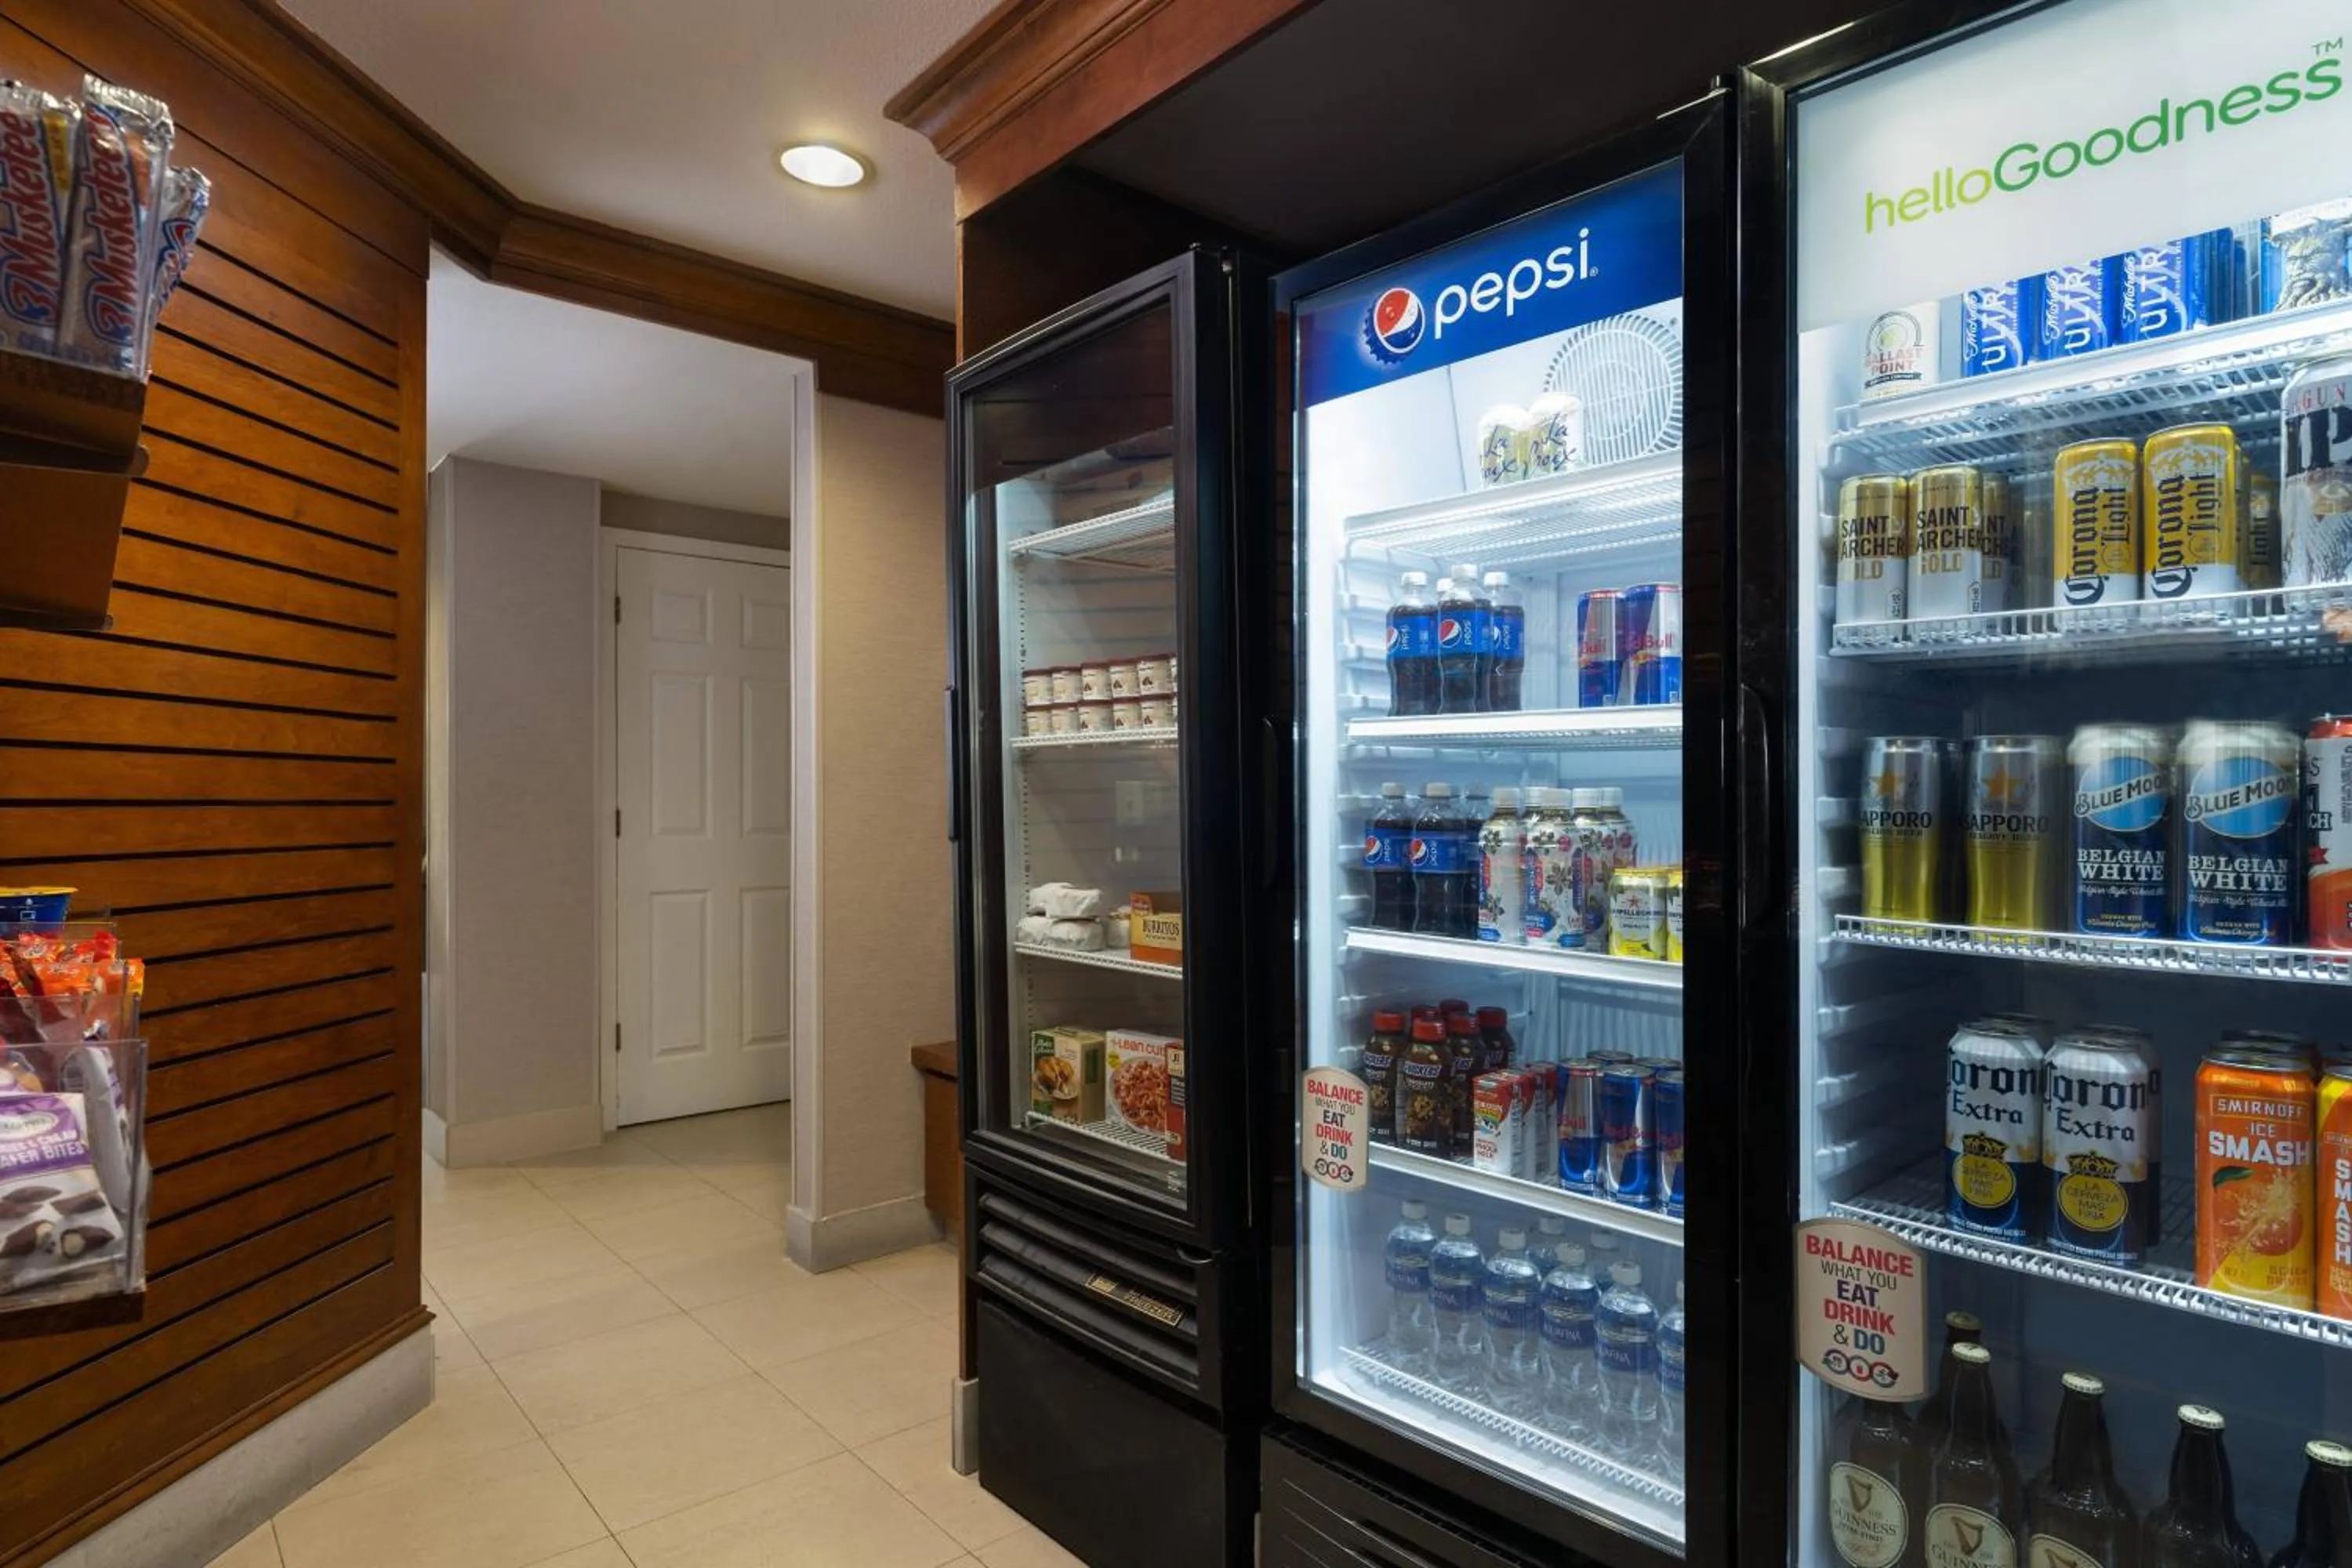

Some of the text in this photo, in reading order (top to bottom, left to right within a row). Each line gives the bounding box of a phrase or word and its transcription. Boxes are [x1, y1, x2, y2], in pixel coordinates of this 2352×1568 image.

[1865, 59, 2342, 234] helloGoodness
[1, 111, 59, 289] Musketee
[1435, 228, 1589, 339] pepsi
[2140, 252, 2167, 332] ULTR
[2064, 271, 2091, 350] ULTR
[1981, 291, 2007, 366] ULTR
[1841, 515, 1889, 537] SAINT
[1916, 506, 1969, 529] SAINT
[1840, 536, 1906, 560] ARCHER
[2063, 487, 2110, 606] Corona
[2151, 474, 2198, 599] Corona
[1861, 809, 1933, 829] APPORO
[2077, 848, 2166, 864] BELGIAN
[2078, 862, 2165, 881] WHITE
[2187, 855, 2288, 873] BELGIAN
[2188, 869, 2287, 891] WHITE
[1307, 1078, 1363, 1105] BALANCE
[1949, 1058, 2037, 1096] oron
[1339, 1102, 1356, 1116] YOU
[1952, 1091, 2024, 1125] Extra
[2056, 1105, 2136, 1142] Extra
[2218, 1098, 2304, 1117] SMIRNOFF
[1316, 1123, 1354, 1146] DRINK
[2249, 1123, 2277, 1138] ICE
[1330, 1143, 1348, 1160] DO
[2208, 1130, 2311, 1167] SMASH
[1806, 1233, 1914, 1278] BALANCE
[1820, 1259, 1898, 1291] WHAT YOU
[1824, 1298, 1896, 1337] DRINK
[1833, 1323, 1886, 1356] & DO
